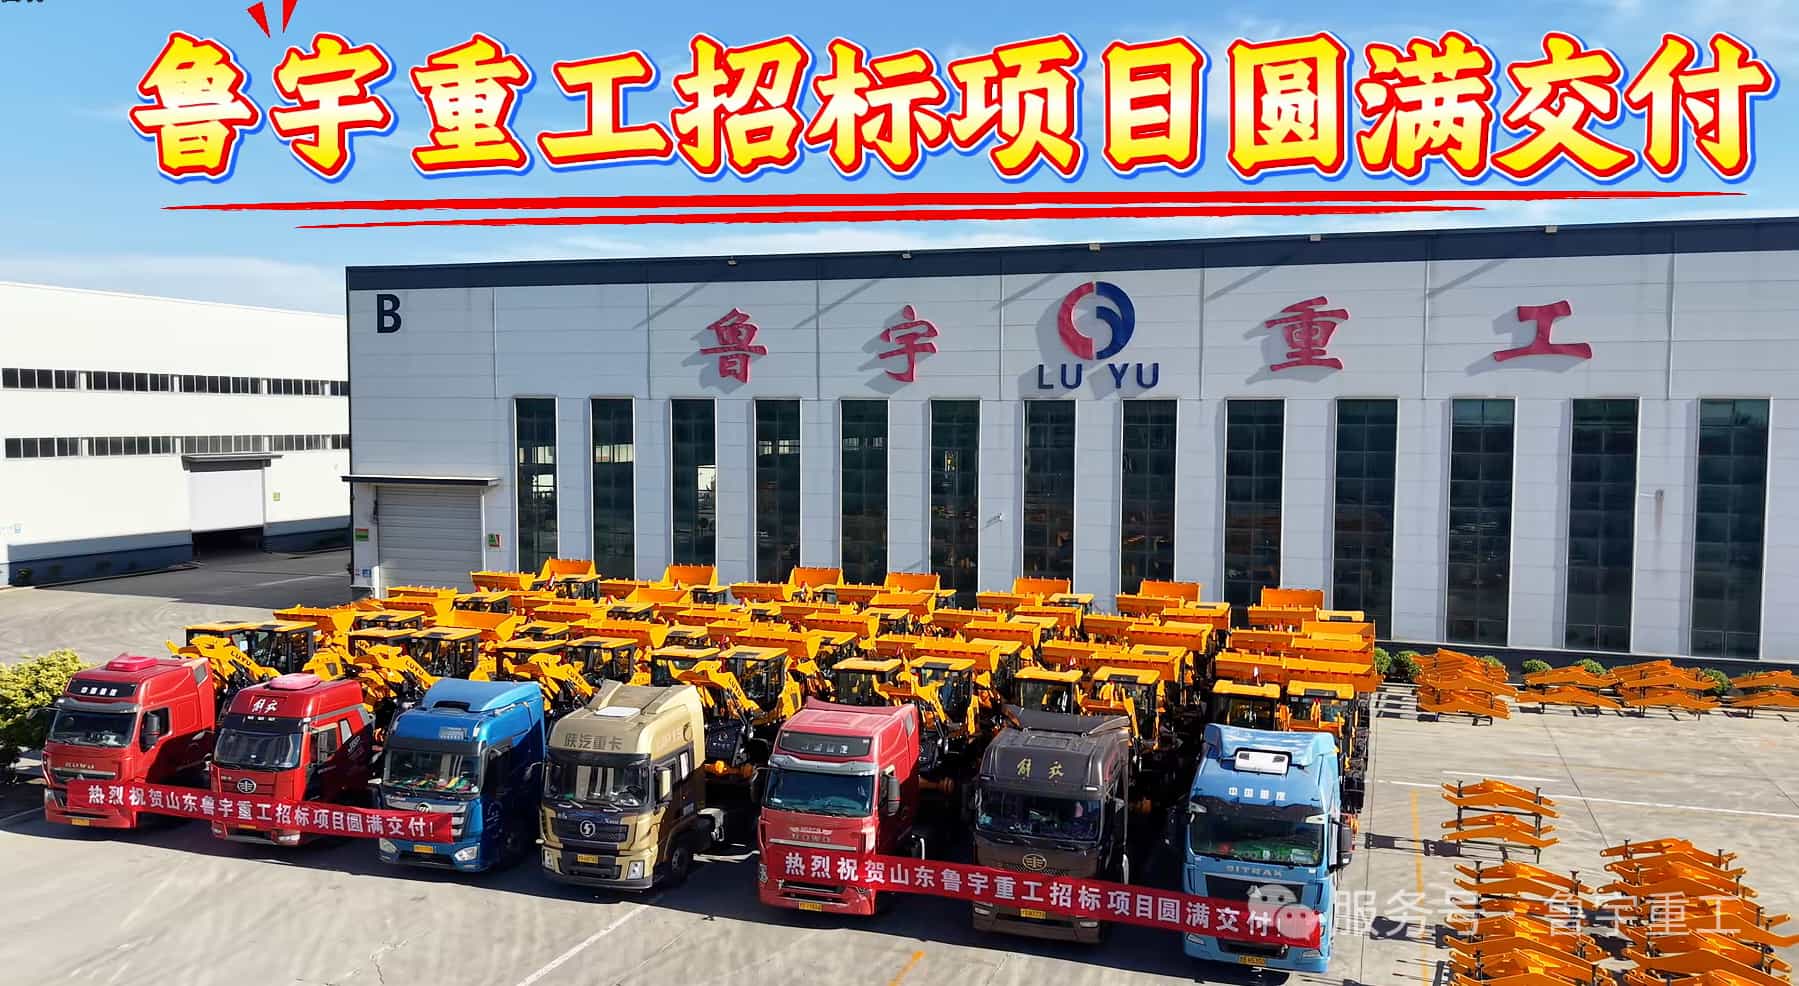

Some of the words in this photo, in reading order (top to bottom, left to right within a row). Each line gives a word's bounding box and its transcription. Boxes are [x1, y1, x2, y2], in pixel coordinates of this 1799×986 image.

[376, 293, 402, 334] B
[1037, 363, 1083, 389] LU
[1108, 363, 1161, 389] YU
[564, 732, 623, 751] 陕汽重卡
